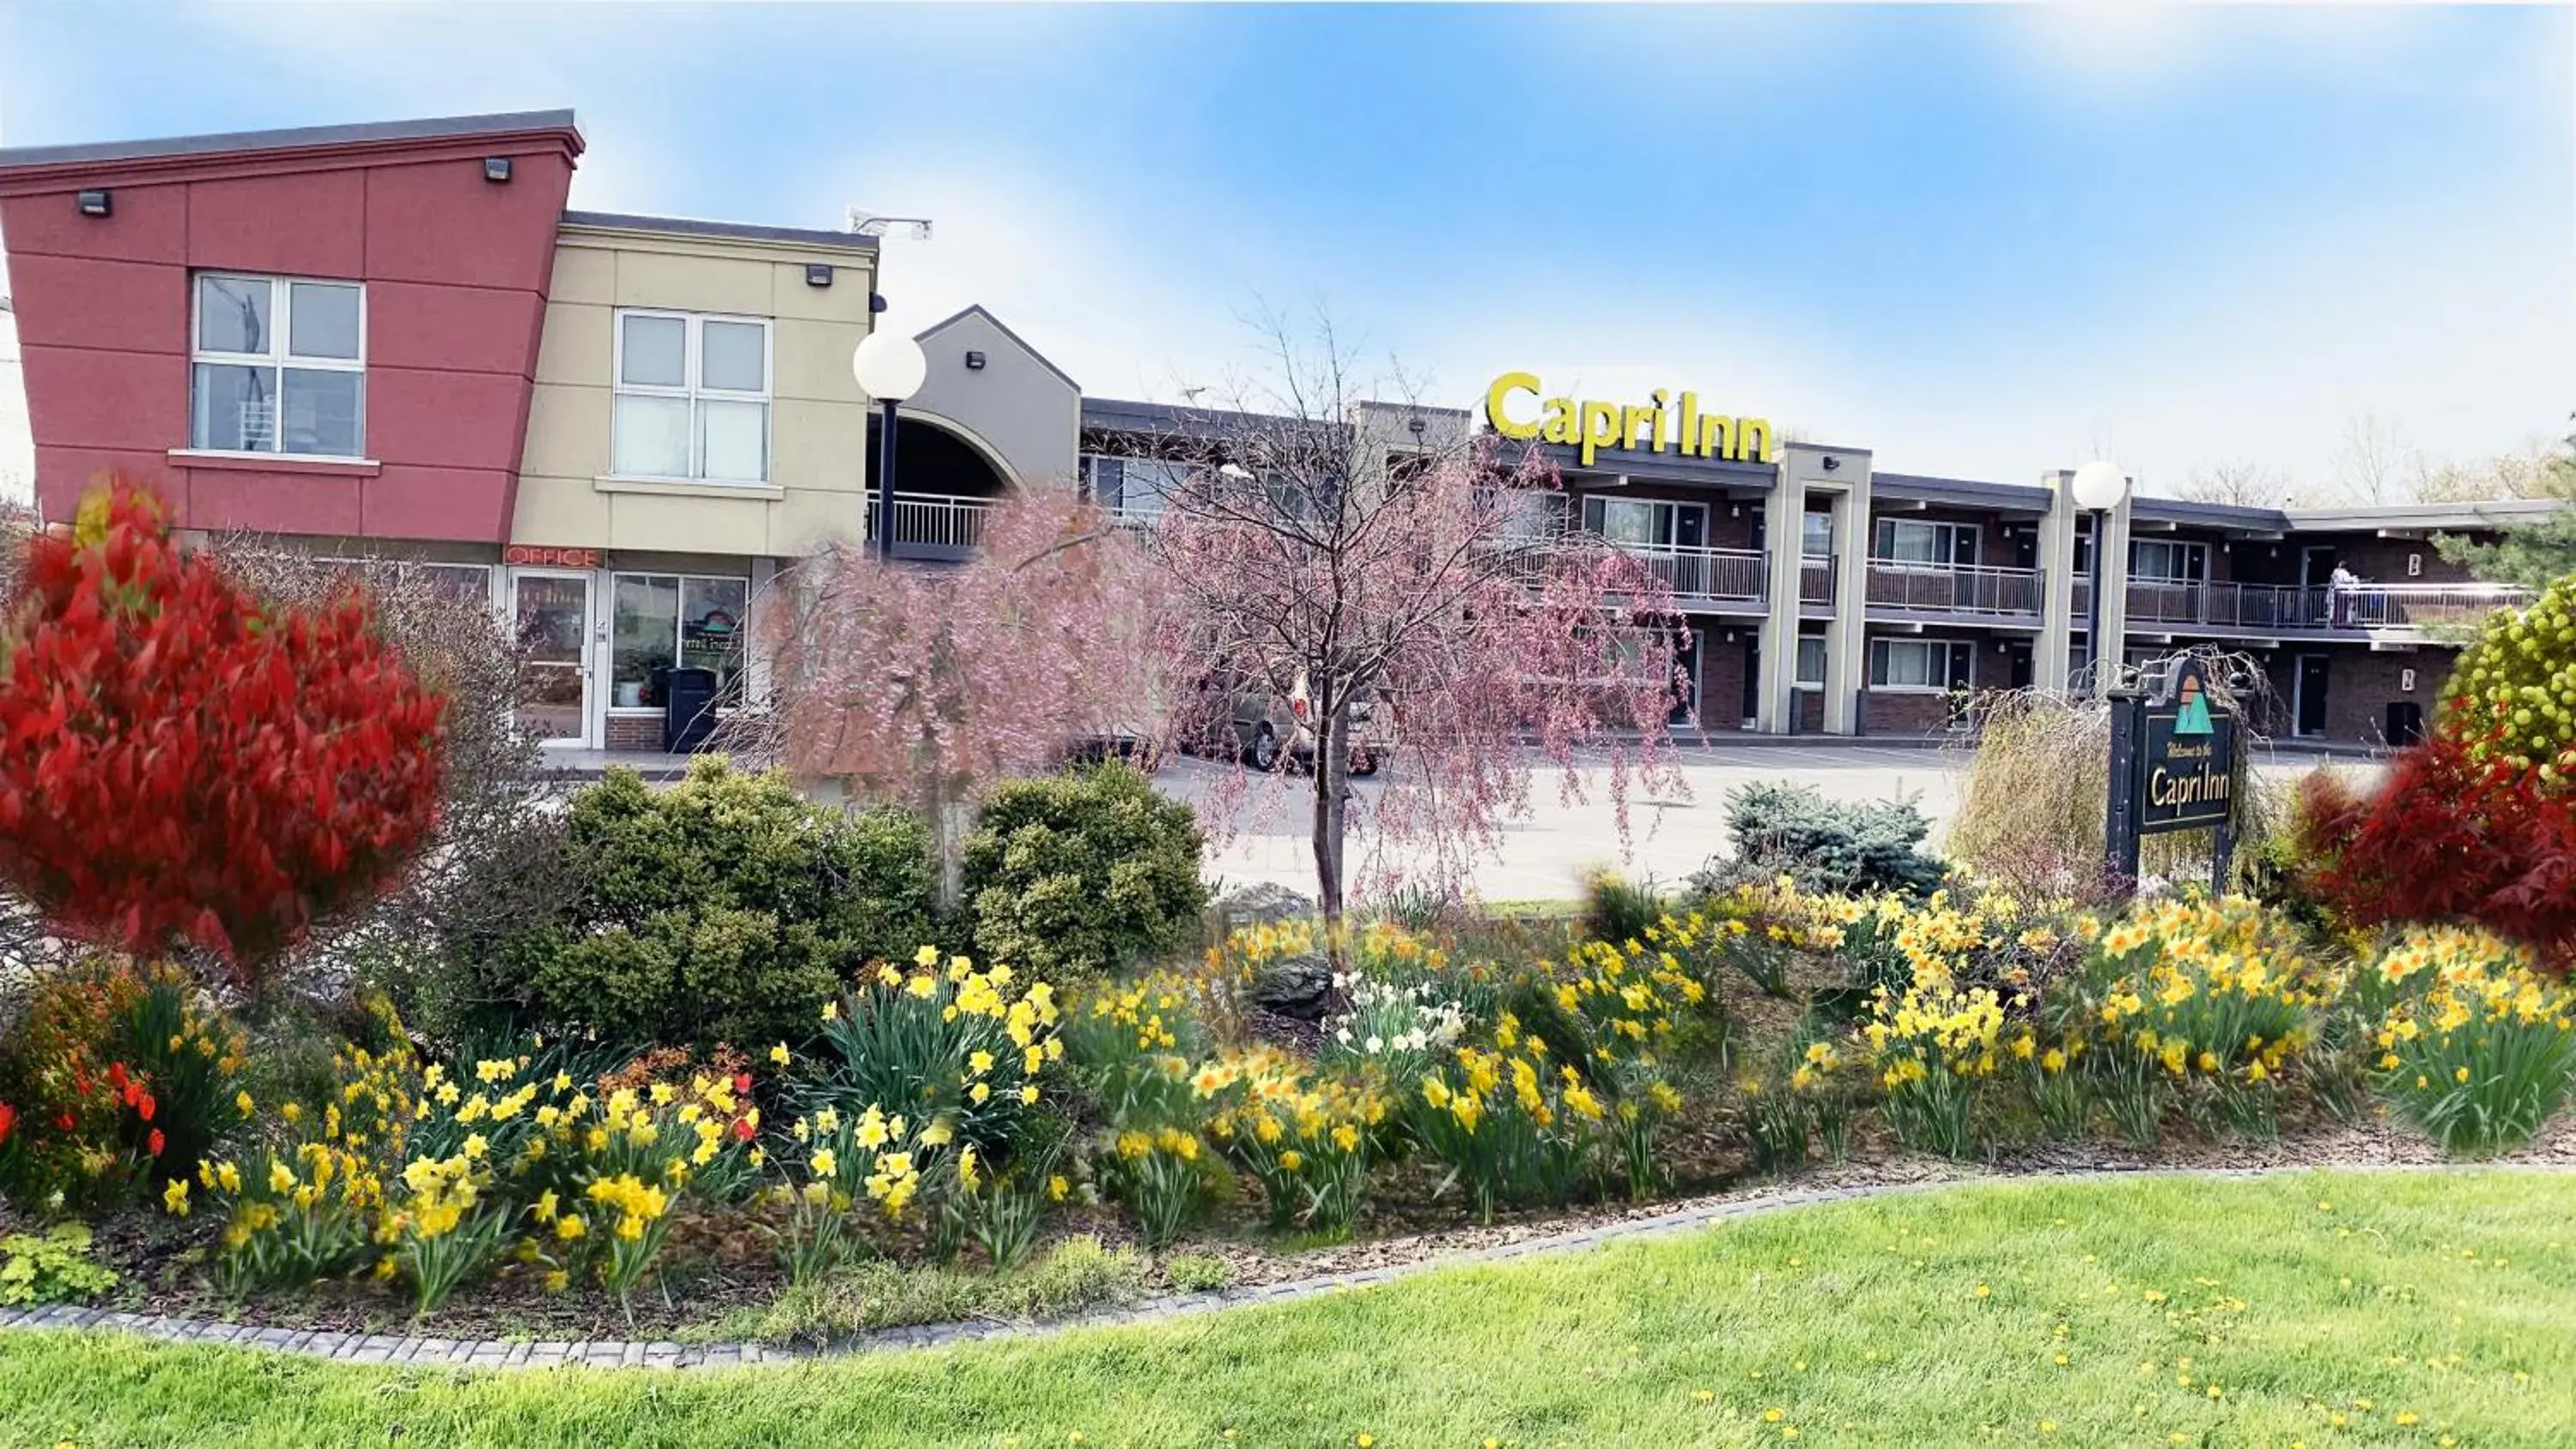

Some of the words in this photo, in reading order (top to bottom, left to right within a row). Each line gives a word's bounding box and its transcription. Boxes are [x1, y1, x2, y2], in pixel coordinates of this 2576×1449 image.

[1485, 372, 1668, 465] Capri
[1679, 391, 1771, 462] Inn
[507, 547, 597, 566] OFFICE
[2151, 764, 2202, 816] Capri
[2203, 761, 2230, 800] Inn
